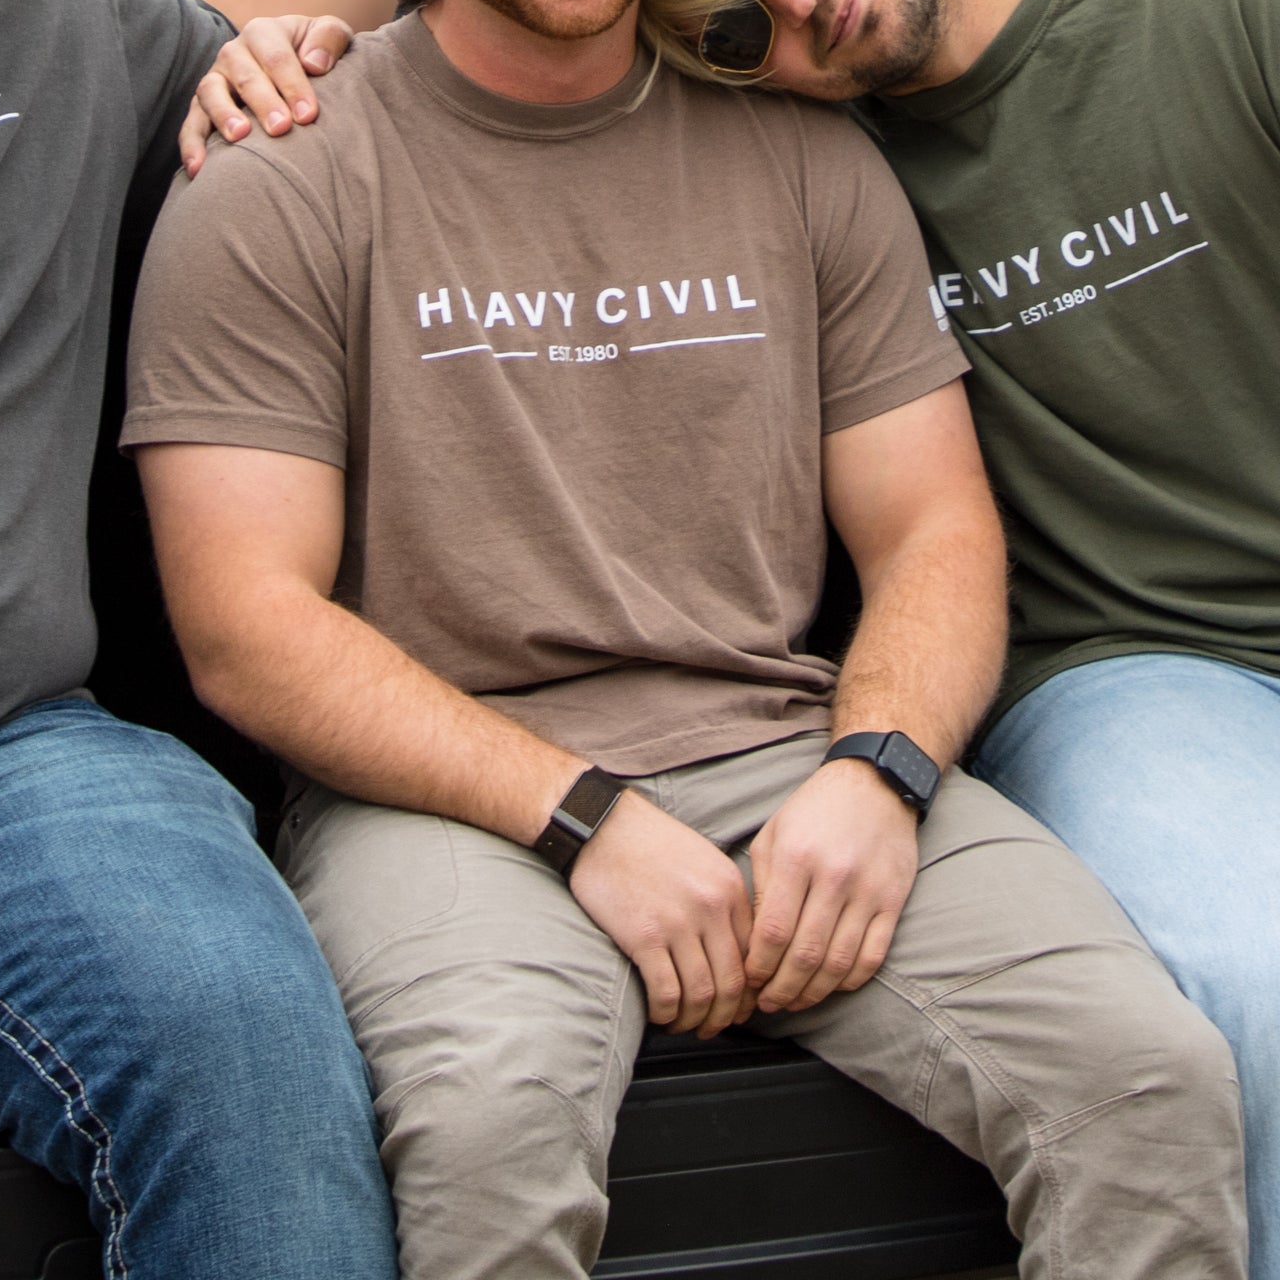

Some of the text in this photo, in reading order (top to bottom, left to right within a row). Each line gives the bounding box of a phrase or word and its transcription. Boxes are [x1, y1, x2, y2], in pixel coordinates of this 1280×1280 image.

[1060, 191, 1190, 268] CIVIL
[596, 274, 757, 325] CIVIL
[1019, 284, 1098, 326] EST. 1980
[548, 343, 619, 363] EST. 1980
